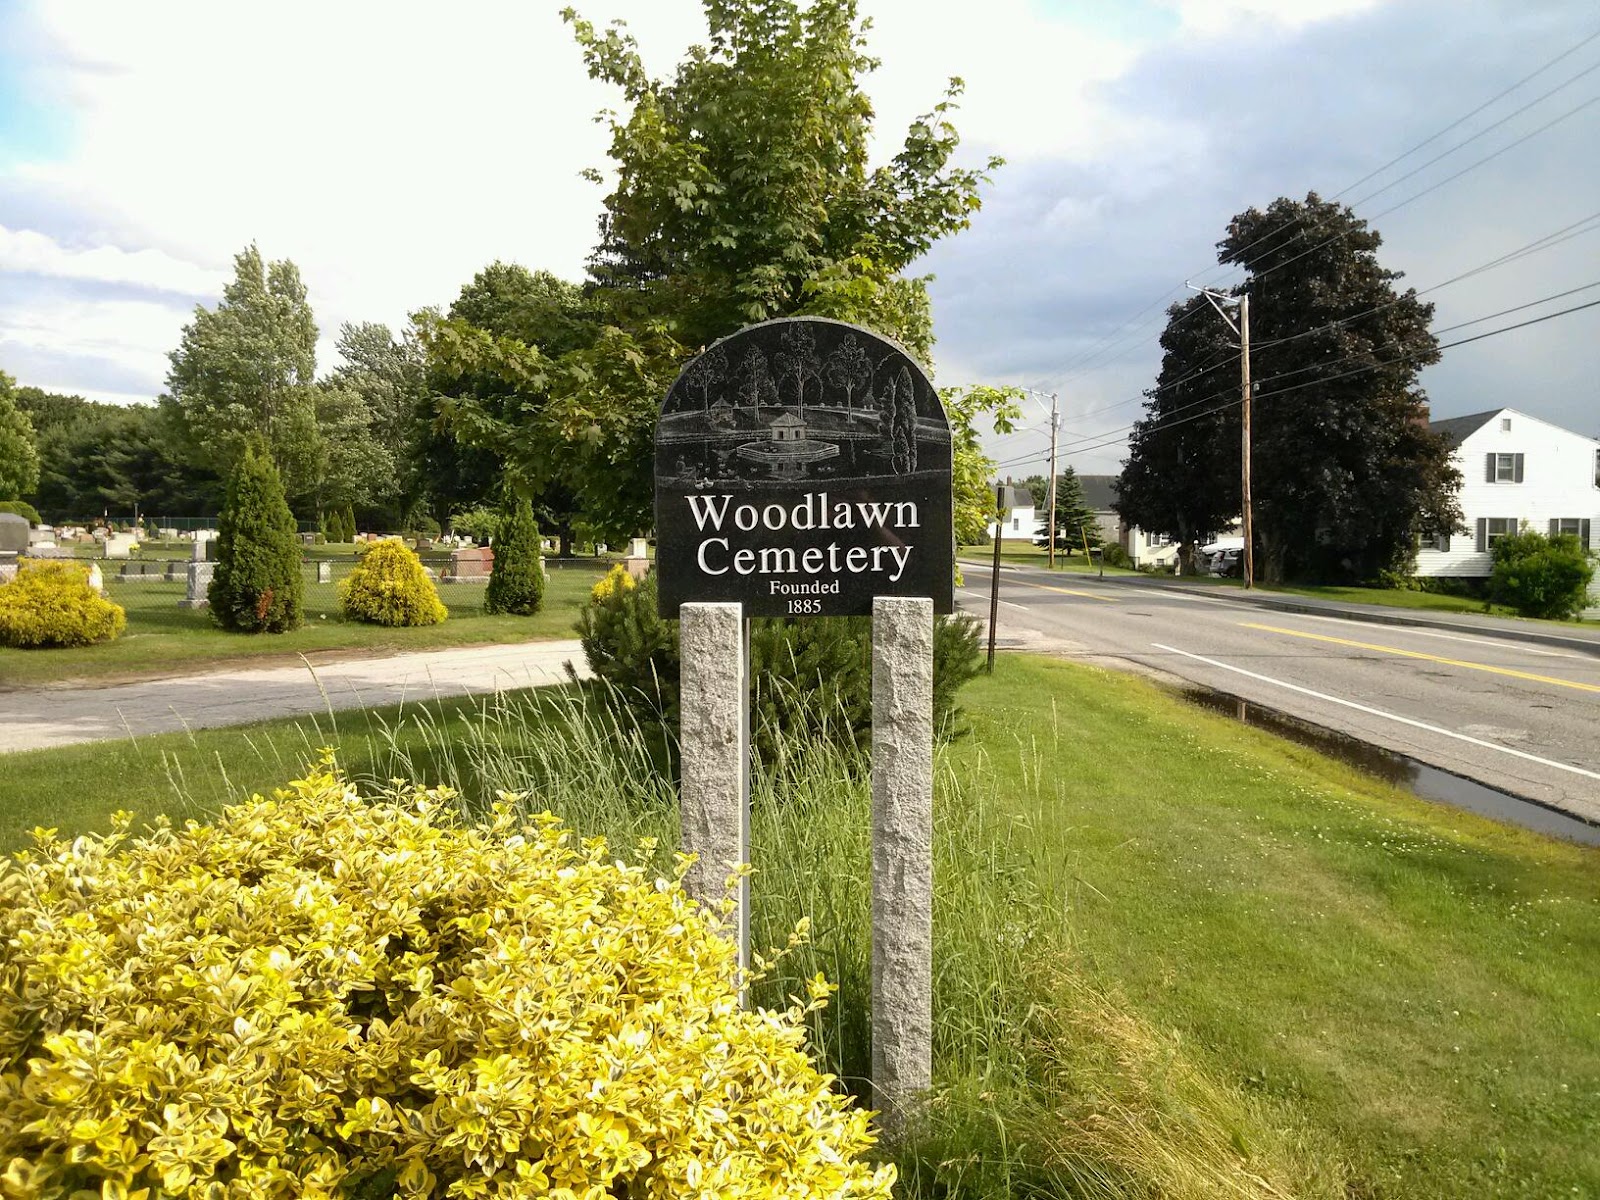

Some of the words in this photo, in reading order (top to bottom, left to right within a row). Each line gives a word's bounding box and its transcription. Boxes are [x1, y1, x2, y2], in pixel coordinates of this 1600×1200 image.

[685, 492, 920, 531] Woodlawn
[697, 537, 913, 582] Cemetery
[769, 580, 840, 595] Founded
[787, 599, 822, 614] 1885
